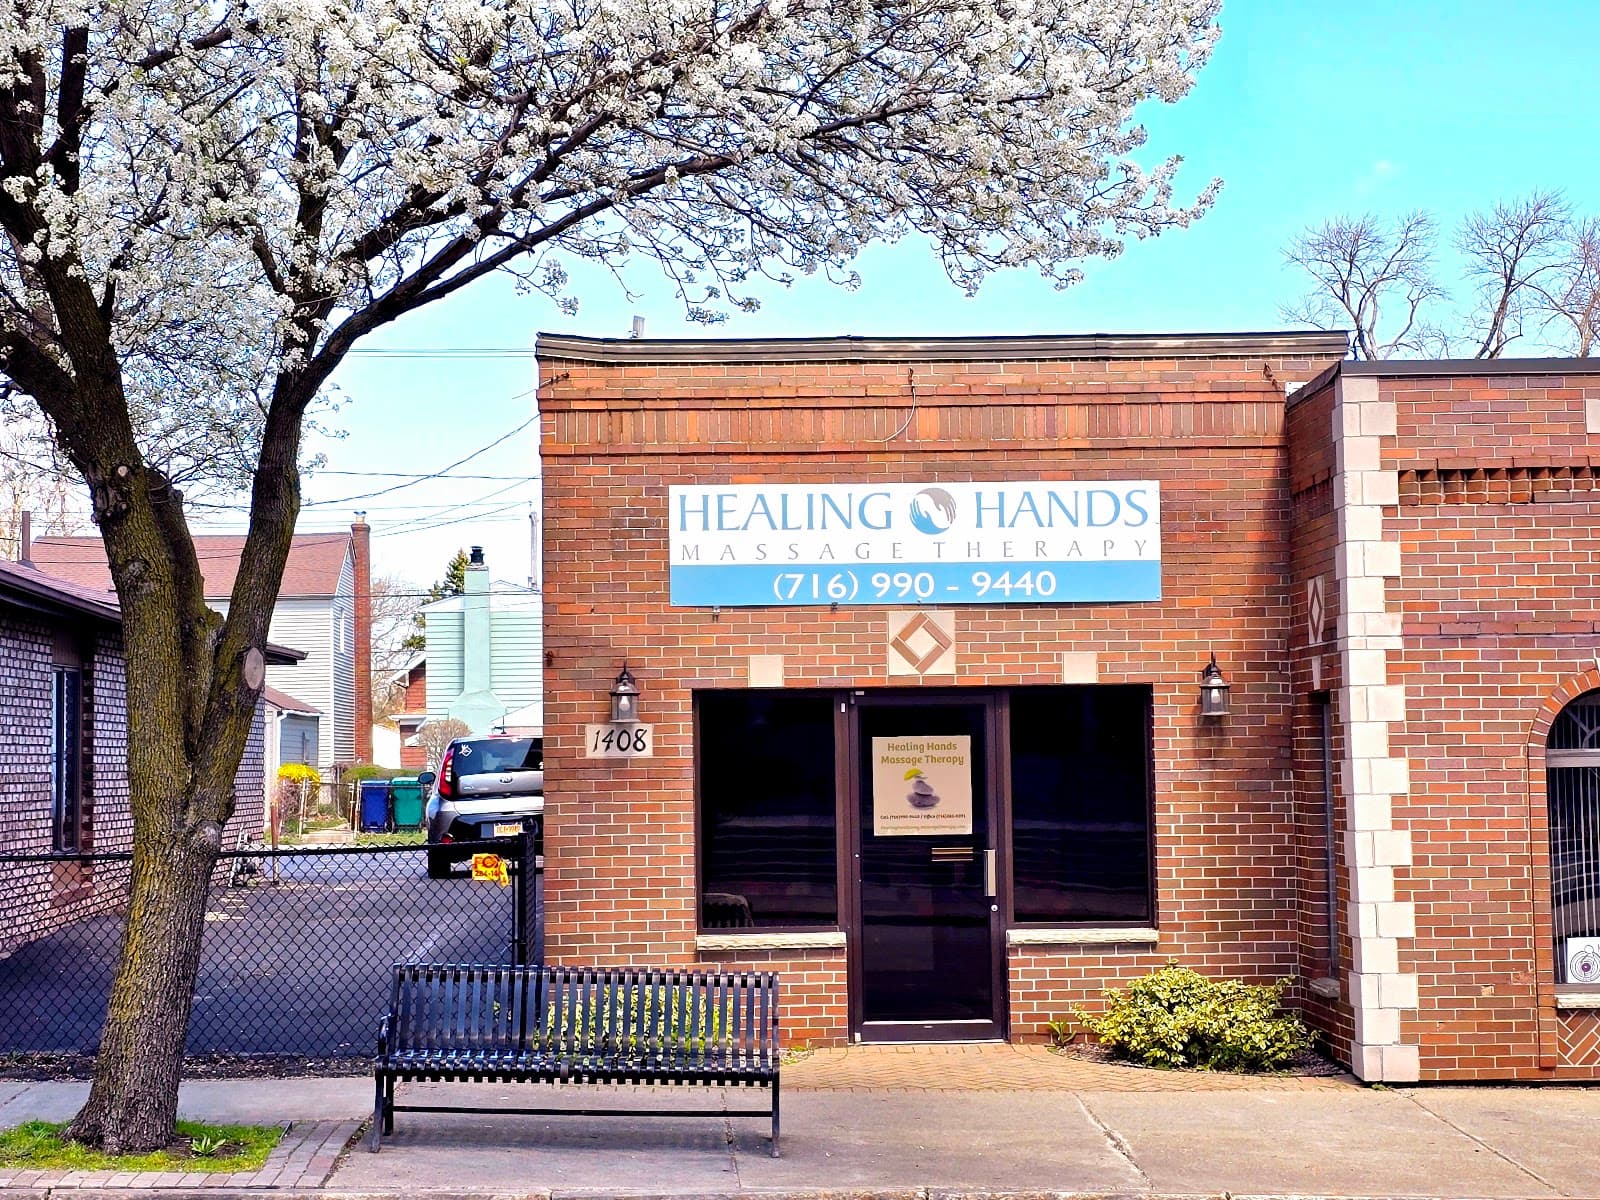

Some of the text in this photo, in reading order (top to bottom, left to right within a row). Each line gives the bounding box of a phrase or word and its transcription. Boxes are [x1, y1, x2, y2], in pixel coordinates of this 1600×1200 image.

[679, 489, 1149, 532] HEALING HANDS
[681, 539, 1147, 561] MASSAGE THERAPY
[773, 570, 859, 601] (716)
[871, 572, 935, 598] 990
[971, 570, 1057, 597] 9440
[592, 728, 648, 753] 1408
[887, 741, 958, 753] Healing Hands
[881, 754, 965, 766] Massage Therapy
